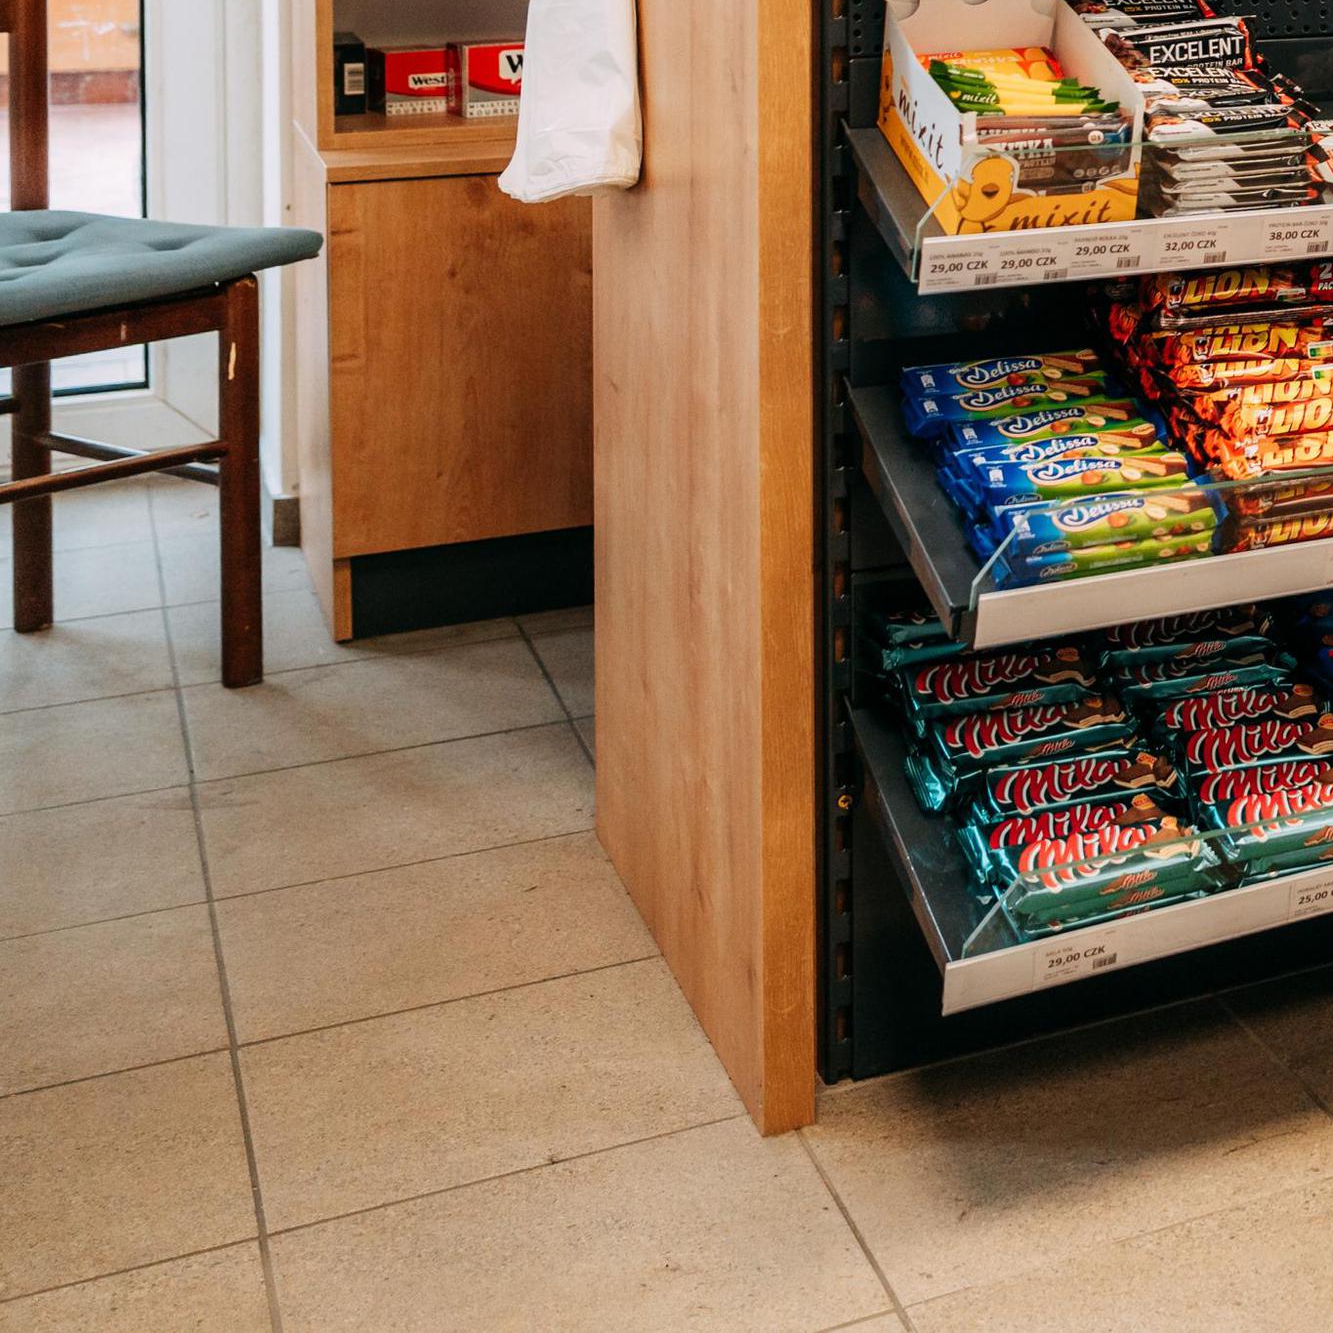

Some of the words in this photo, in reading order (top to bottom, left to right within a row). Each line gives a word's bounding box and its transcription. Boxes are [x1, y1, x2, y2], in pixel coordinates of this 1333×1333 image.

[1150, 36, 1242, 65] EXCELENT
[411, 75, 446, 86] West
[1010, 198, 1113, 231] mixit
[930, 261, 962, 274] 29,00
[965, 260, 989, 272] CZK
[1039, 458, 1117, 481] Delissa
[996, 758, 1131, 815] Mila
